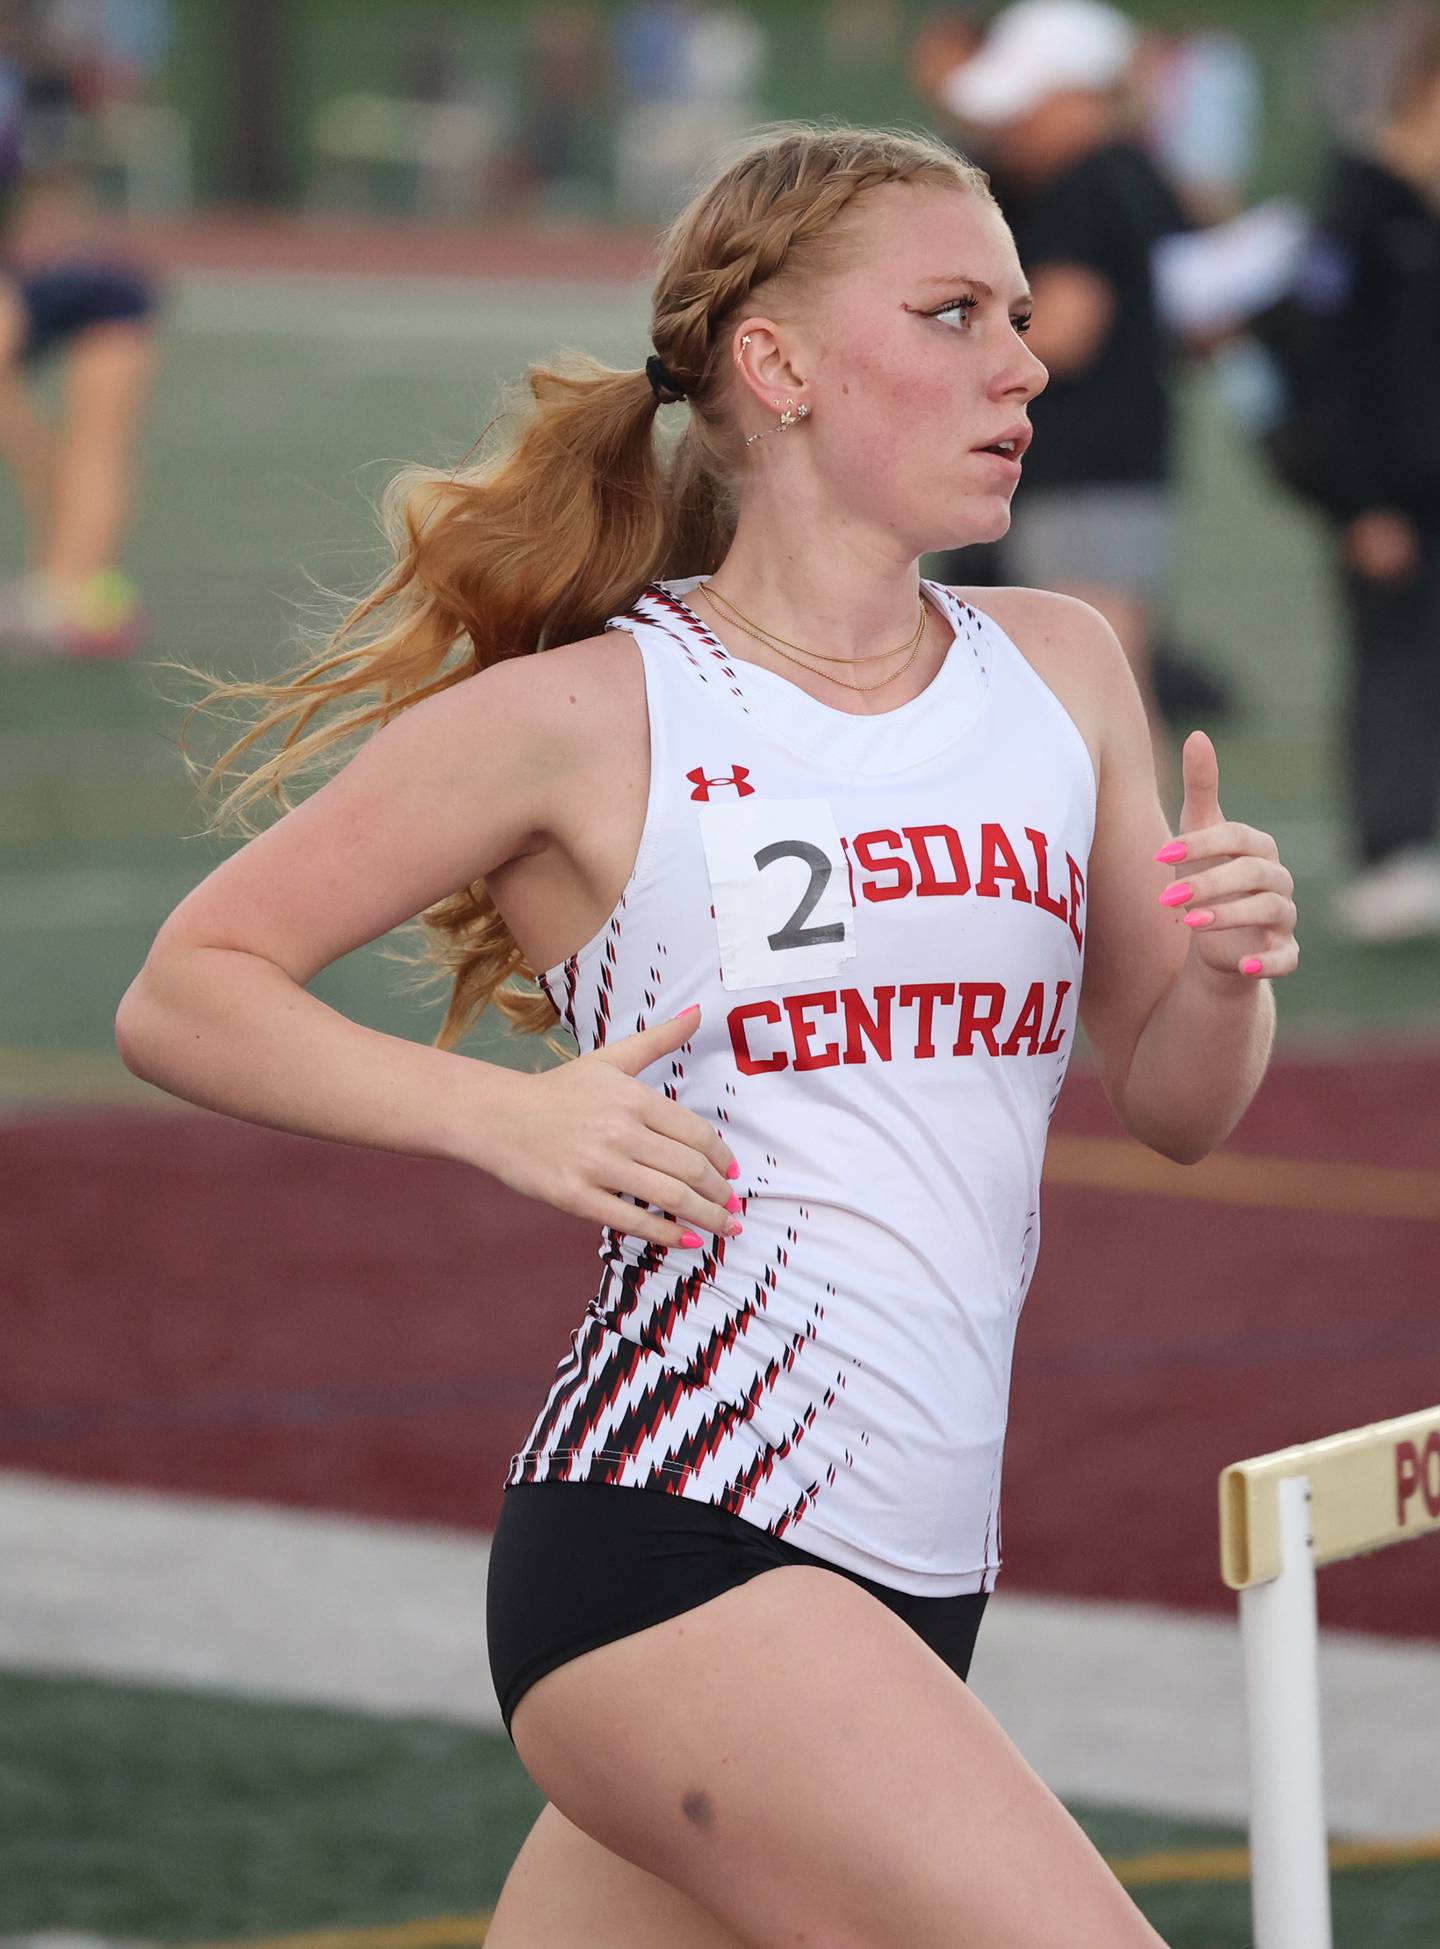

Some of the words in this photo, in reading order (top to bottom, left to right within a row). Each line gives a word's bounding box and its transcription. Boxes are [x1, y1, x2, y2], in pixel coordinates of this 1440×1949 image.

[754, 840, 845, 951] 2
[840, 823, 1085, 954] SDALE
[727, 980, 1072, 1076] CENTRAL
